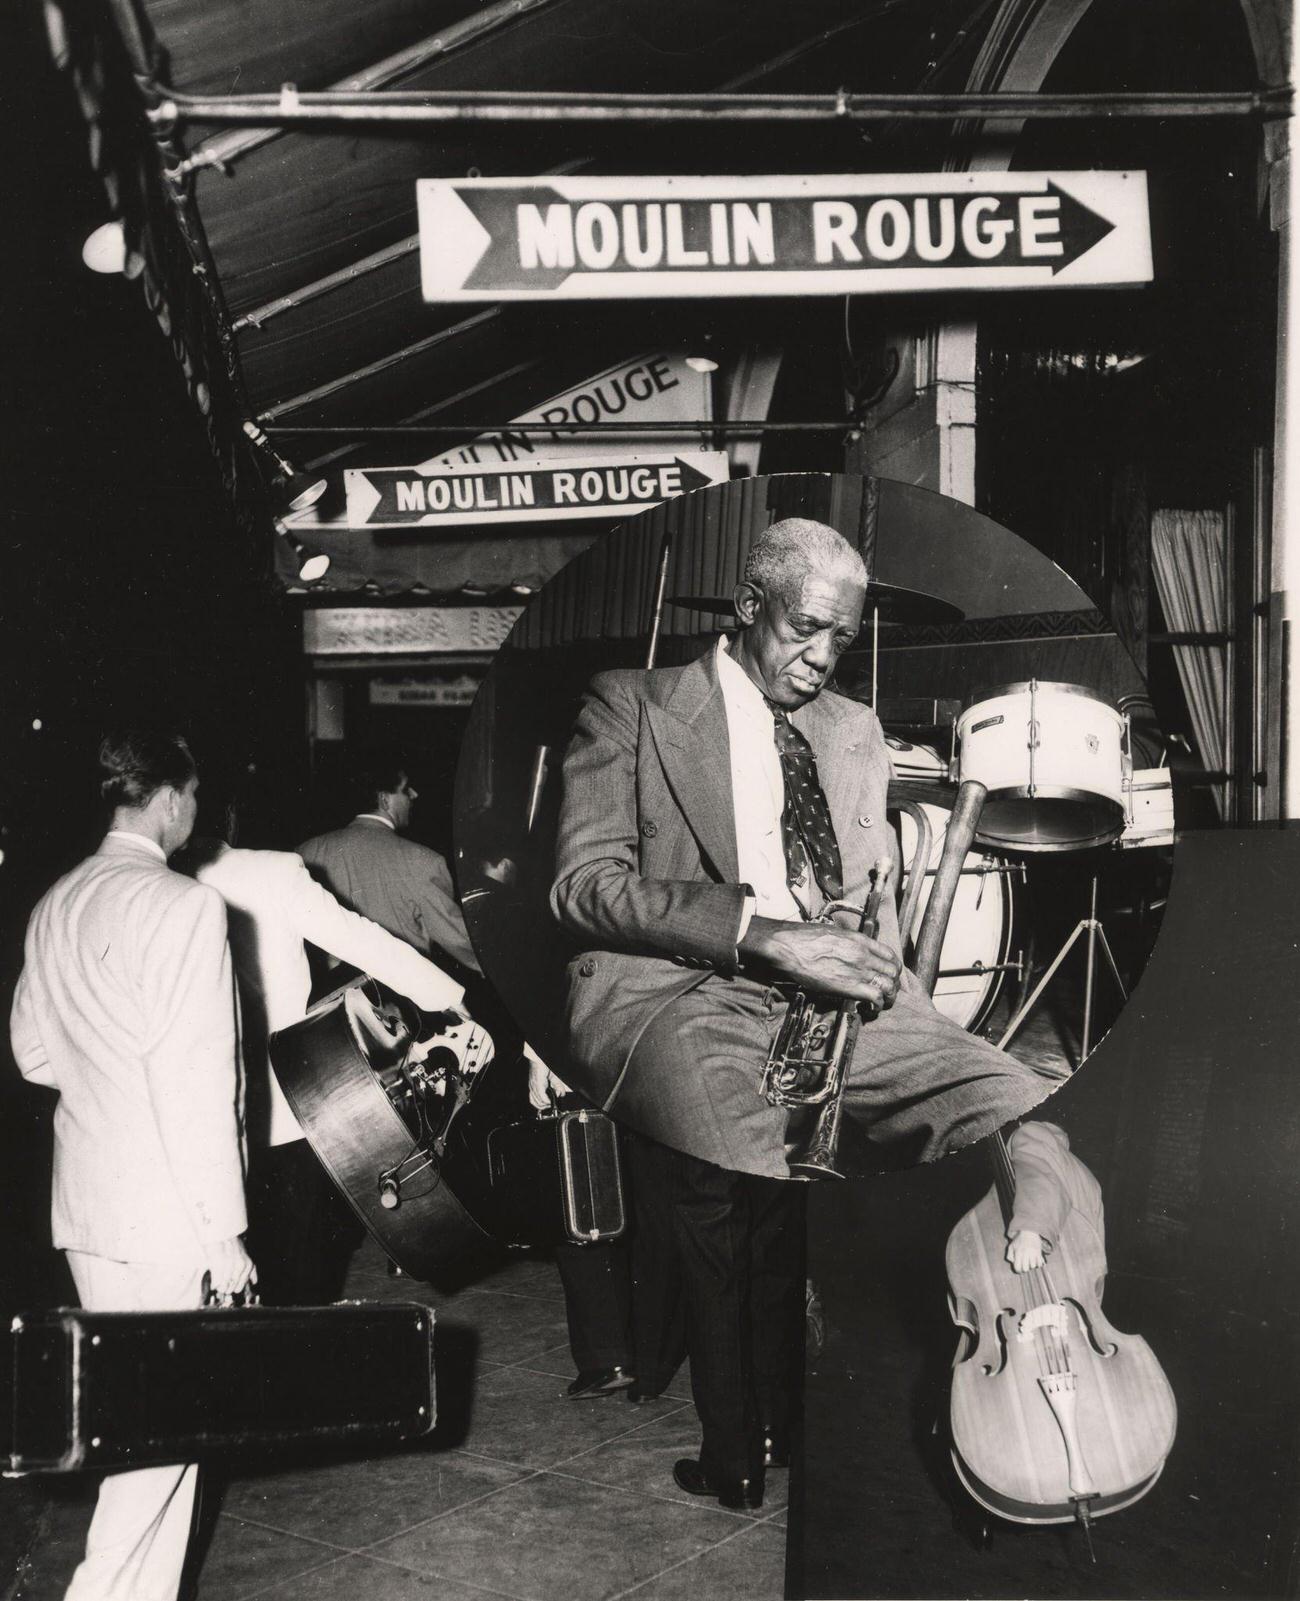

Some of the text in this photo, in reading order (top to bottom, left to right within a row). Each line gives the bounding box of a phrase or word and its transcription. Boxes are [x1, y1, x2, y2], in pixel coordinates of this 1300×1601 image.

[516, 196, 1064, 269] MOULIN ROUGE
[396, 467, 683, 511] MOULIN ROUGE
